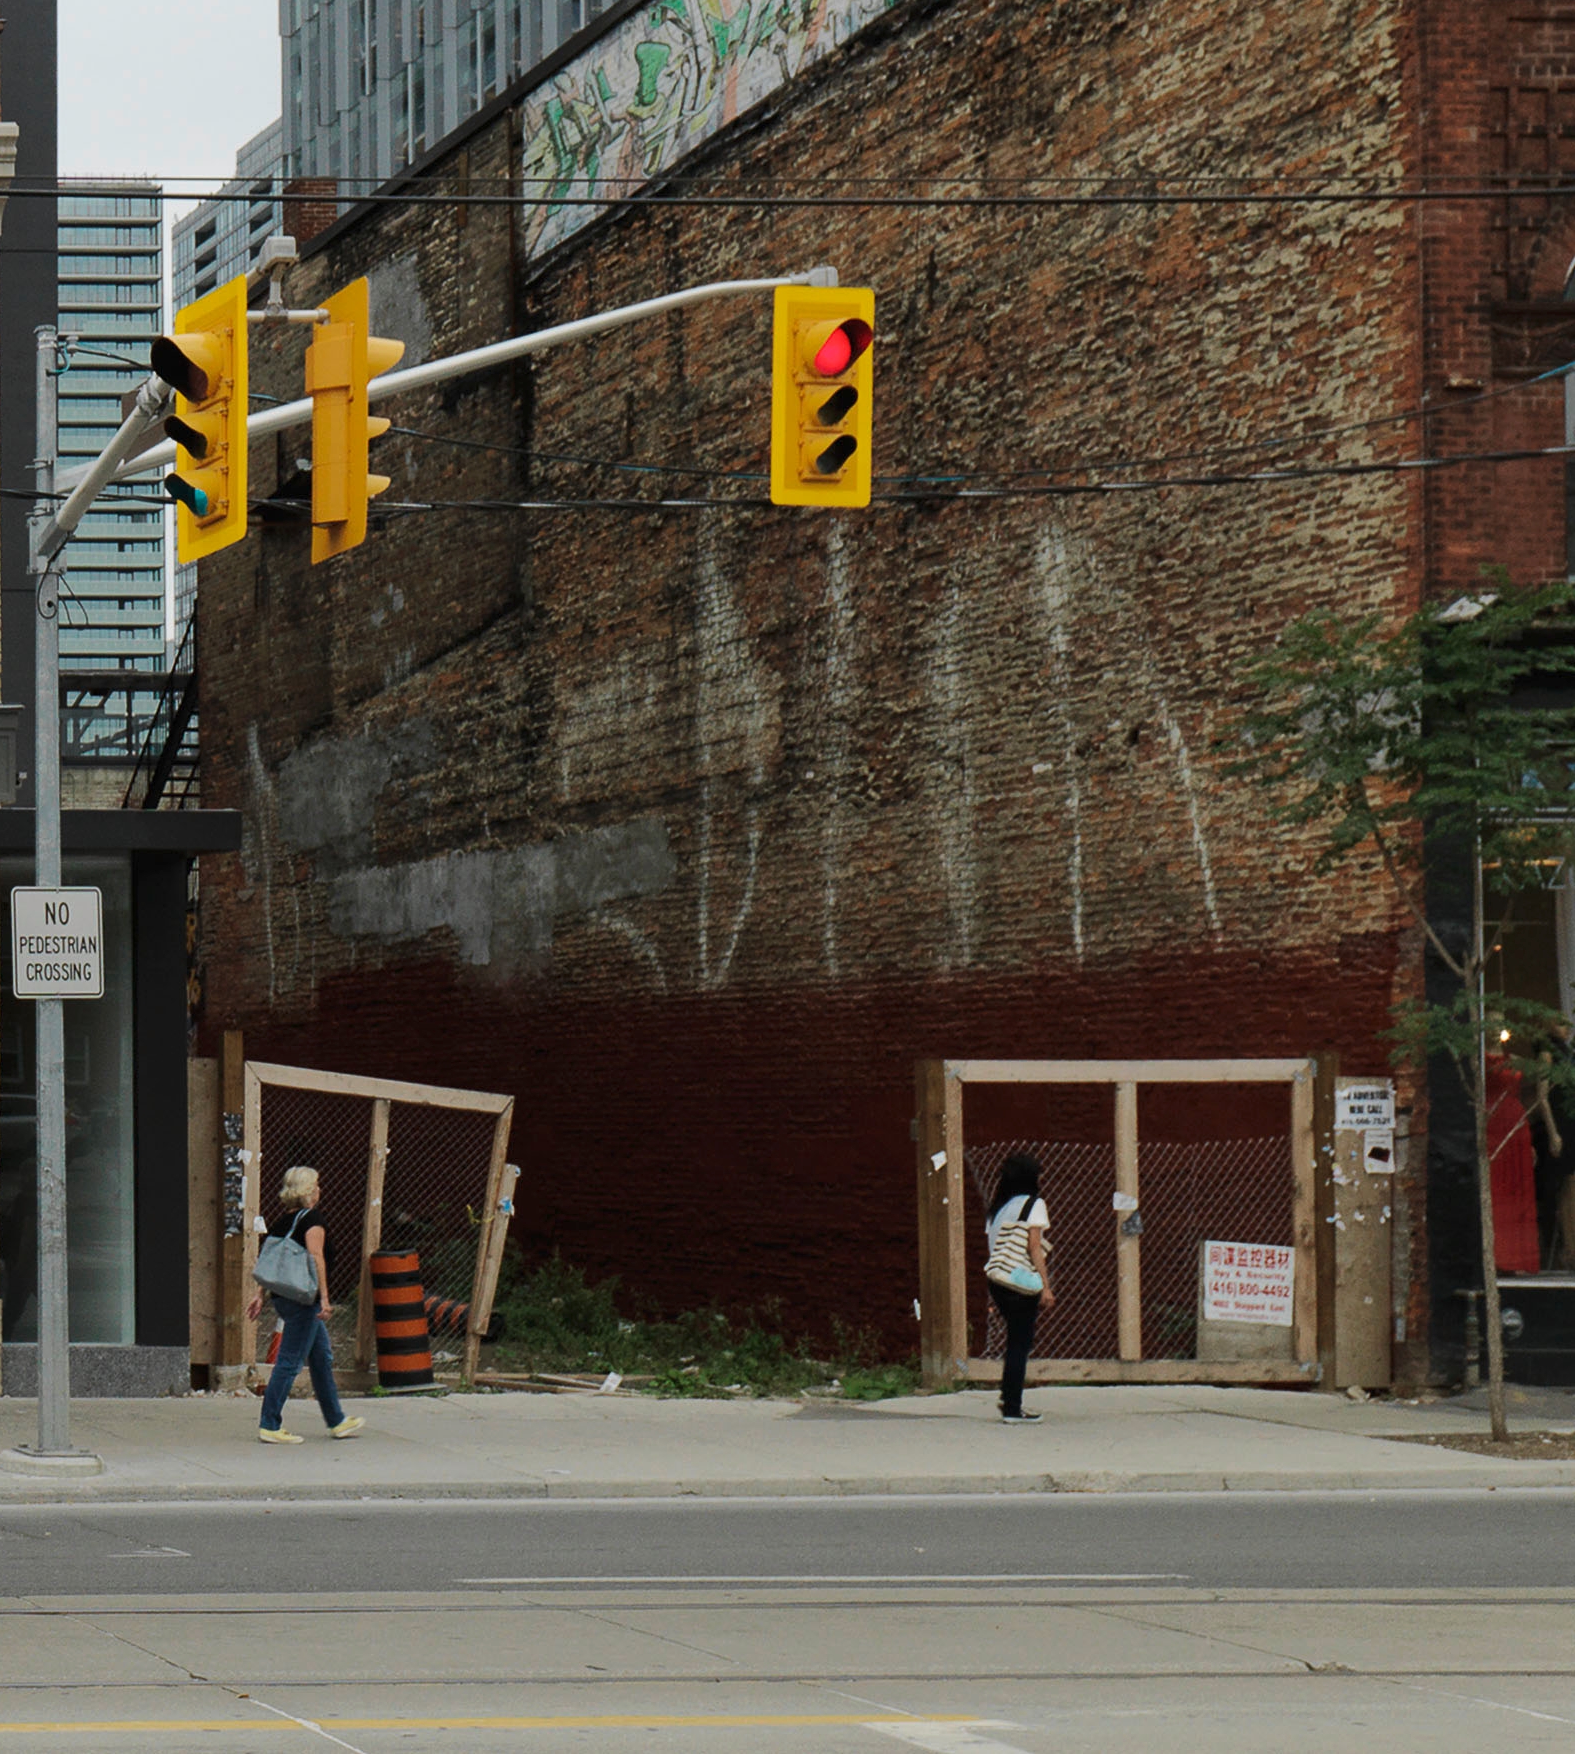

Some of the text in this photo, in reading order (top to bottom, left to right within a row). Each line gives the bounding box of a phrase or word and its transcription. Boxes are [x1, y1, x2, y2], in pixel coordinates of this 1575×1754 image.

[44, 901, 70, 926] NO
[19, 936, 97, 955] PEDESTRIAN
[25, 962, 92, 982] CROSSING
